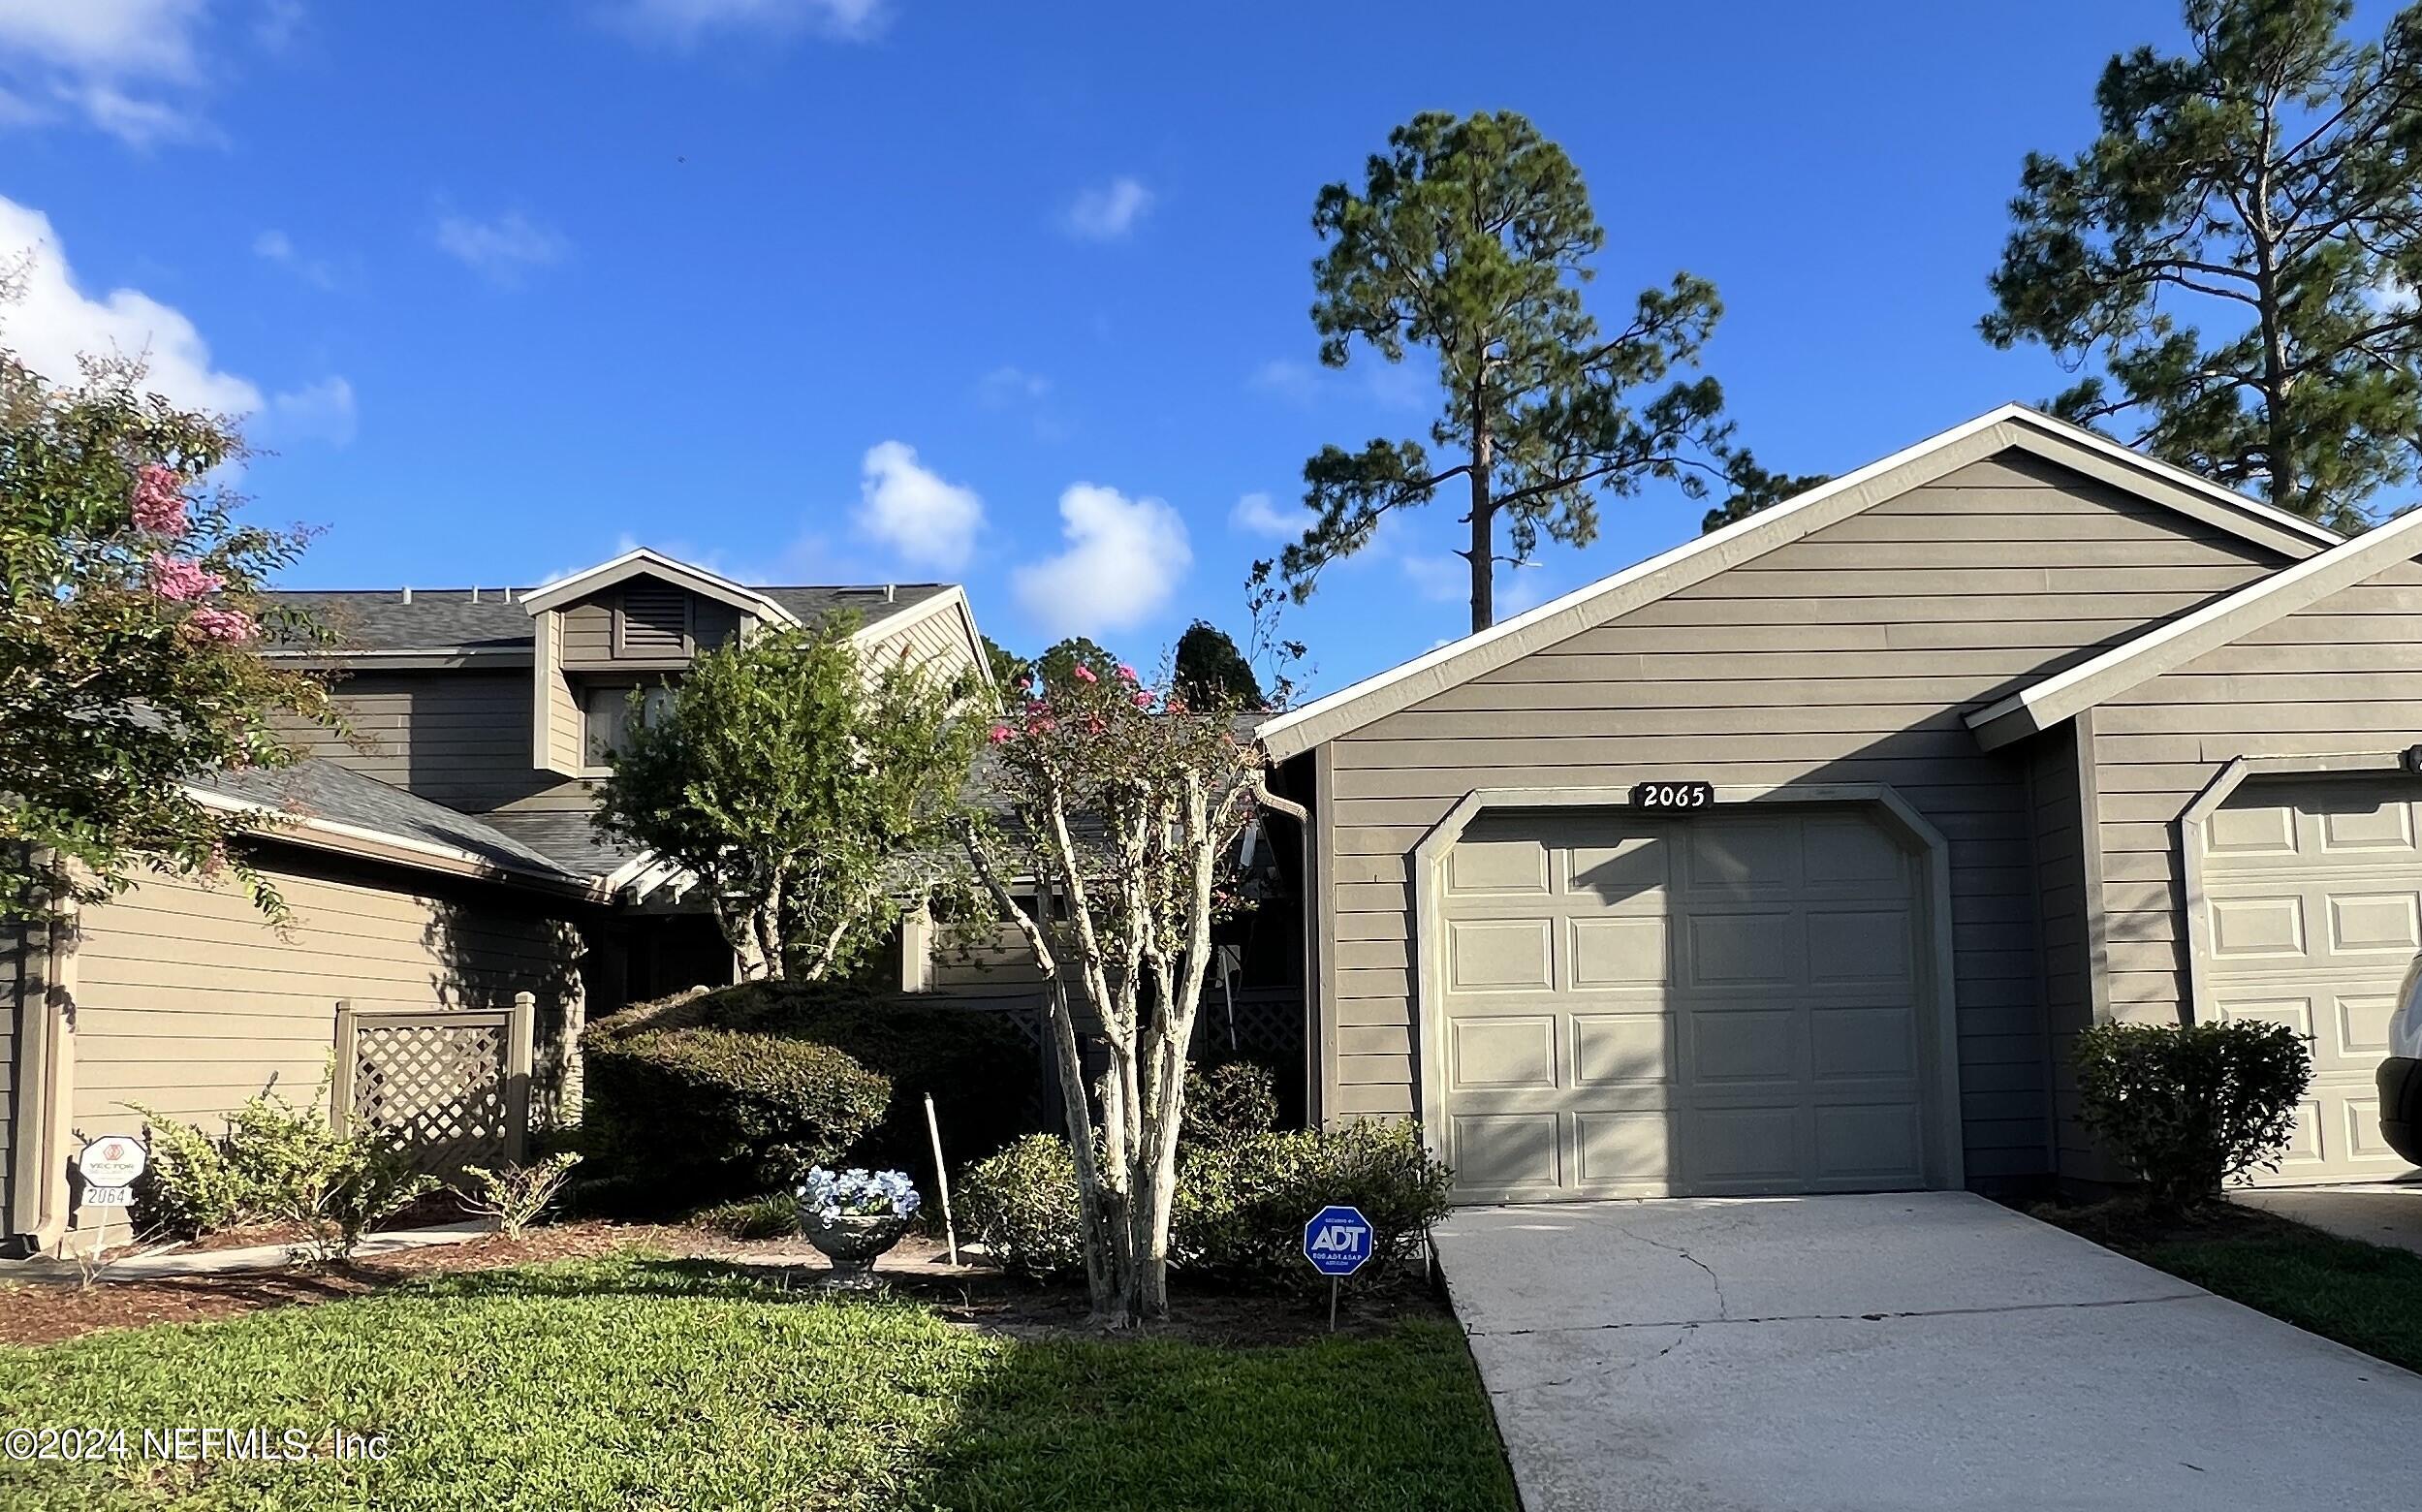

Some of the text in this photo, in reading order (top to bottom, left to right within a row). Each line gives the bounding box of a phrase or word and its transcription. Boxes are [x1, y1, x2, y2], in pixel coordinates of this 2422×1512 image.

[1644, 785, 1705, 806] 2065
[88, 1188, 125, 1204] 2064
[1311, 1225, 1367, 1251] ADT
